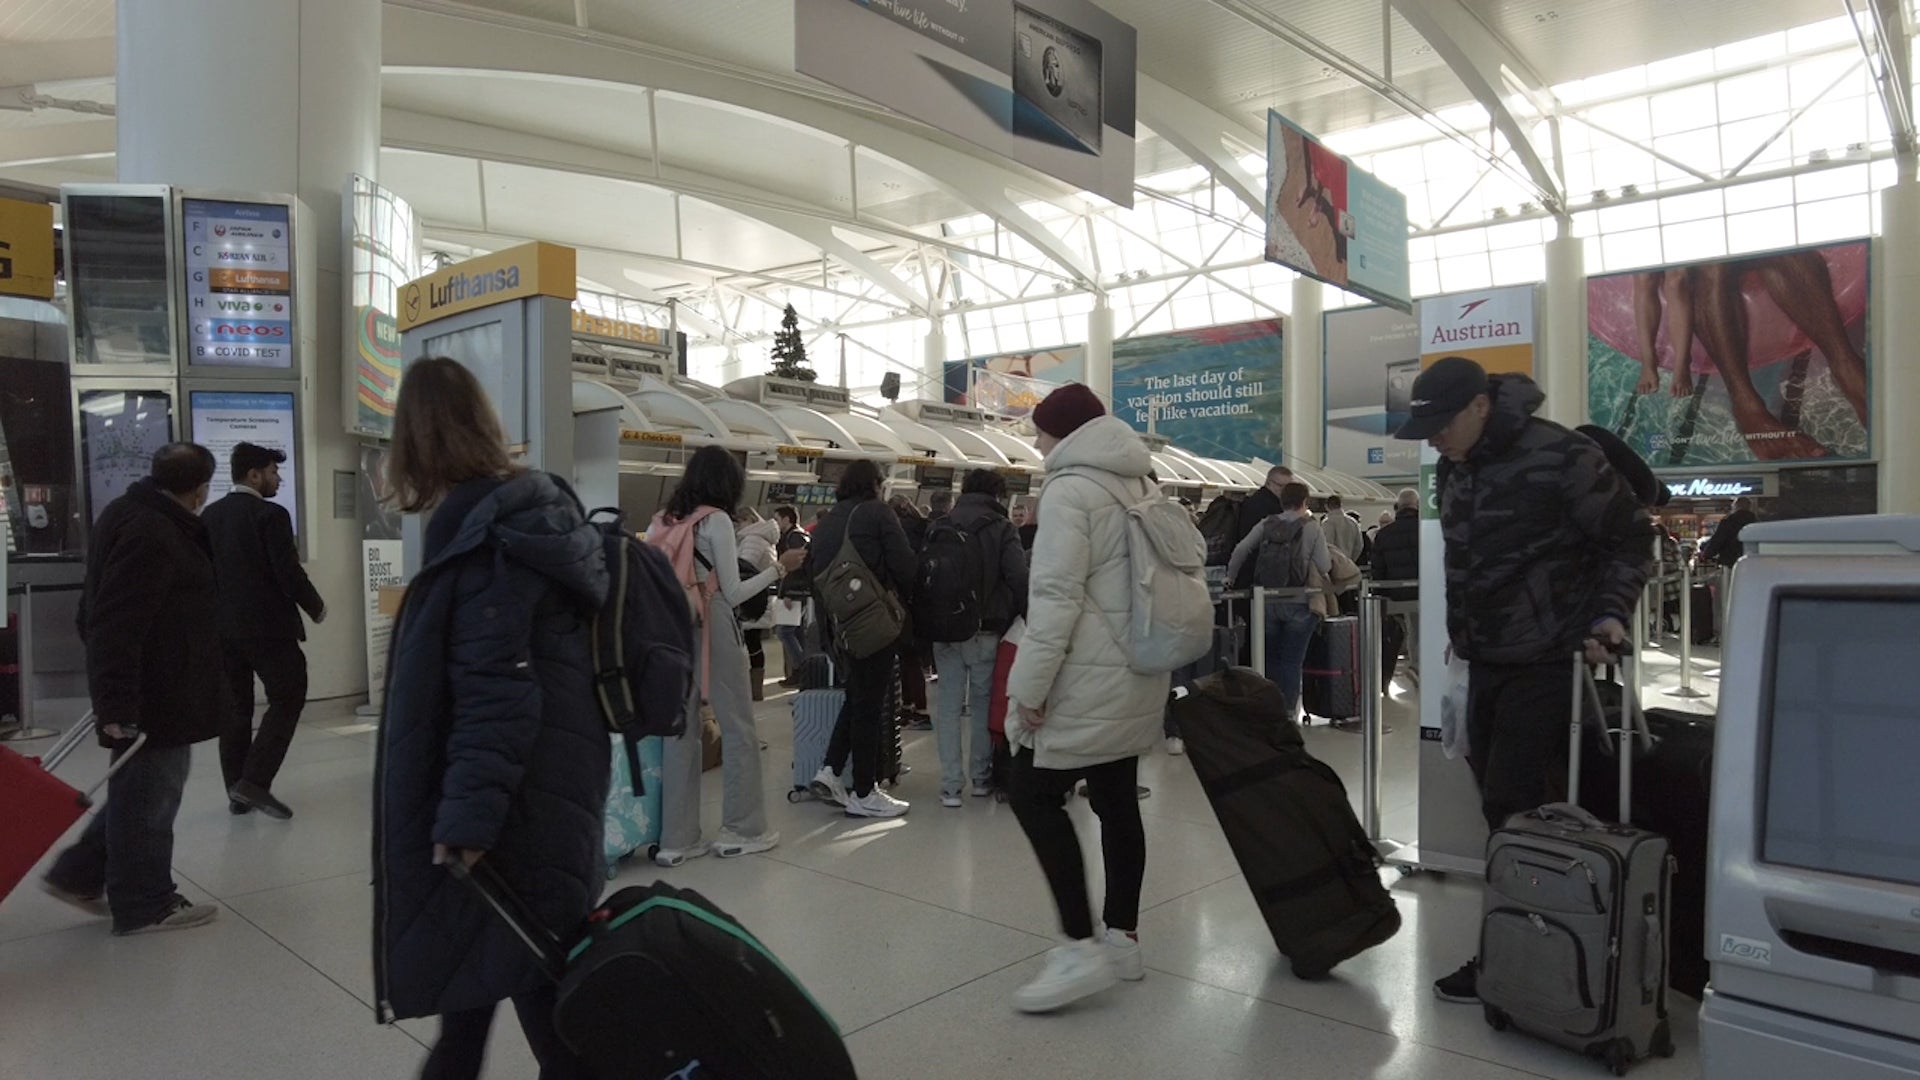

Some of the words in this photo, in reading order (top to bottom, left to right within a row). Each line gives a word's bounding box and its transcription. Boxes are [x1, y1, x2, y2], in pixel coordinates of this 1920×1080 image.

[192, 221, 201, 232] F
[193, 271, 204, 282] G
[235, 274, 280, 285] Lufthansa
[429, 265, 520, 310] Lufthansa
[194, 297, 204, 308] H
[217, 323, 285, 337] neos
[375, 320, 396, 344] NEW
[1431, 319, 1522, 345] Austrian
[196, 345, 206, 357] B
[215, 346, 251, 357] COVID
[256, 348, 281, 358] TEST
[1144, 376, 1171, 392] The
[1173, 374, 1198, 388] last
[1200, 370, 1226, 386] day
[1229, 367, 1245, 382] of
[1127, 391, 1182, 409] vaction
[1184, 385, 1232, 403] should
[1235, 381, 1264, 398] still
[206, 416, 247, 424] Temperature
[249, 417, 280, 425] Screening
[1135, 407, 1160, 424] fel
[1162, 406, 1188, 421] like
[1190, 402, 1254, 419] vacation.
[1744, 431, 1786, 440] WITHOUT
[1787, 430, 1797, 438] IT
[1687, 478, 1753, 496] News
